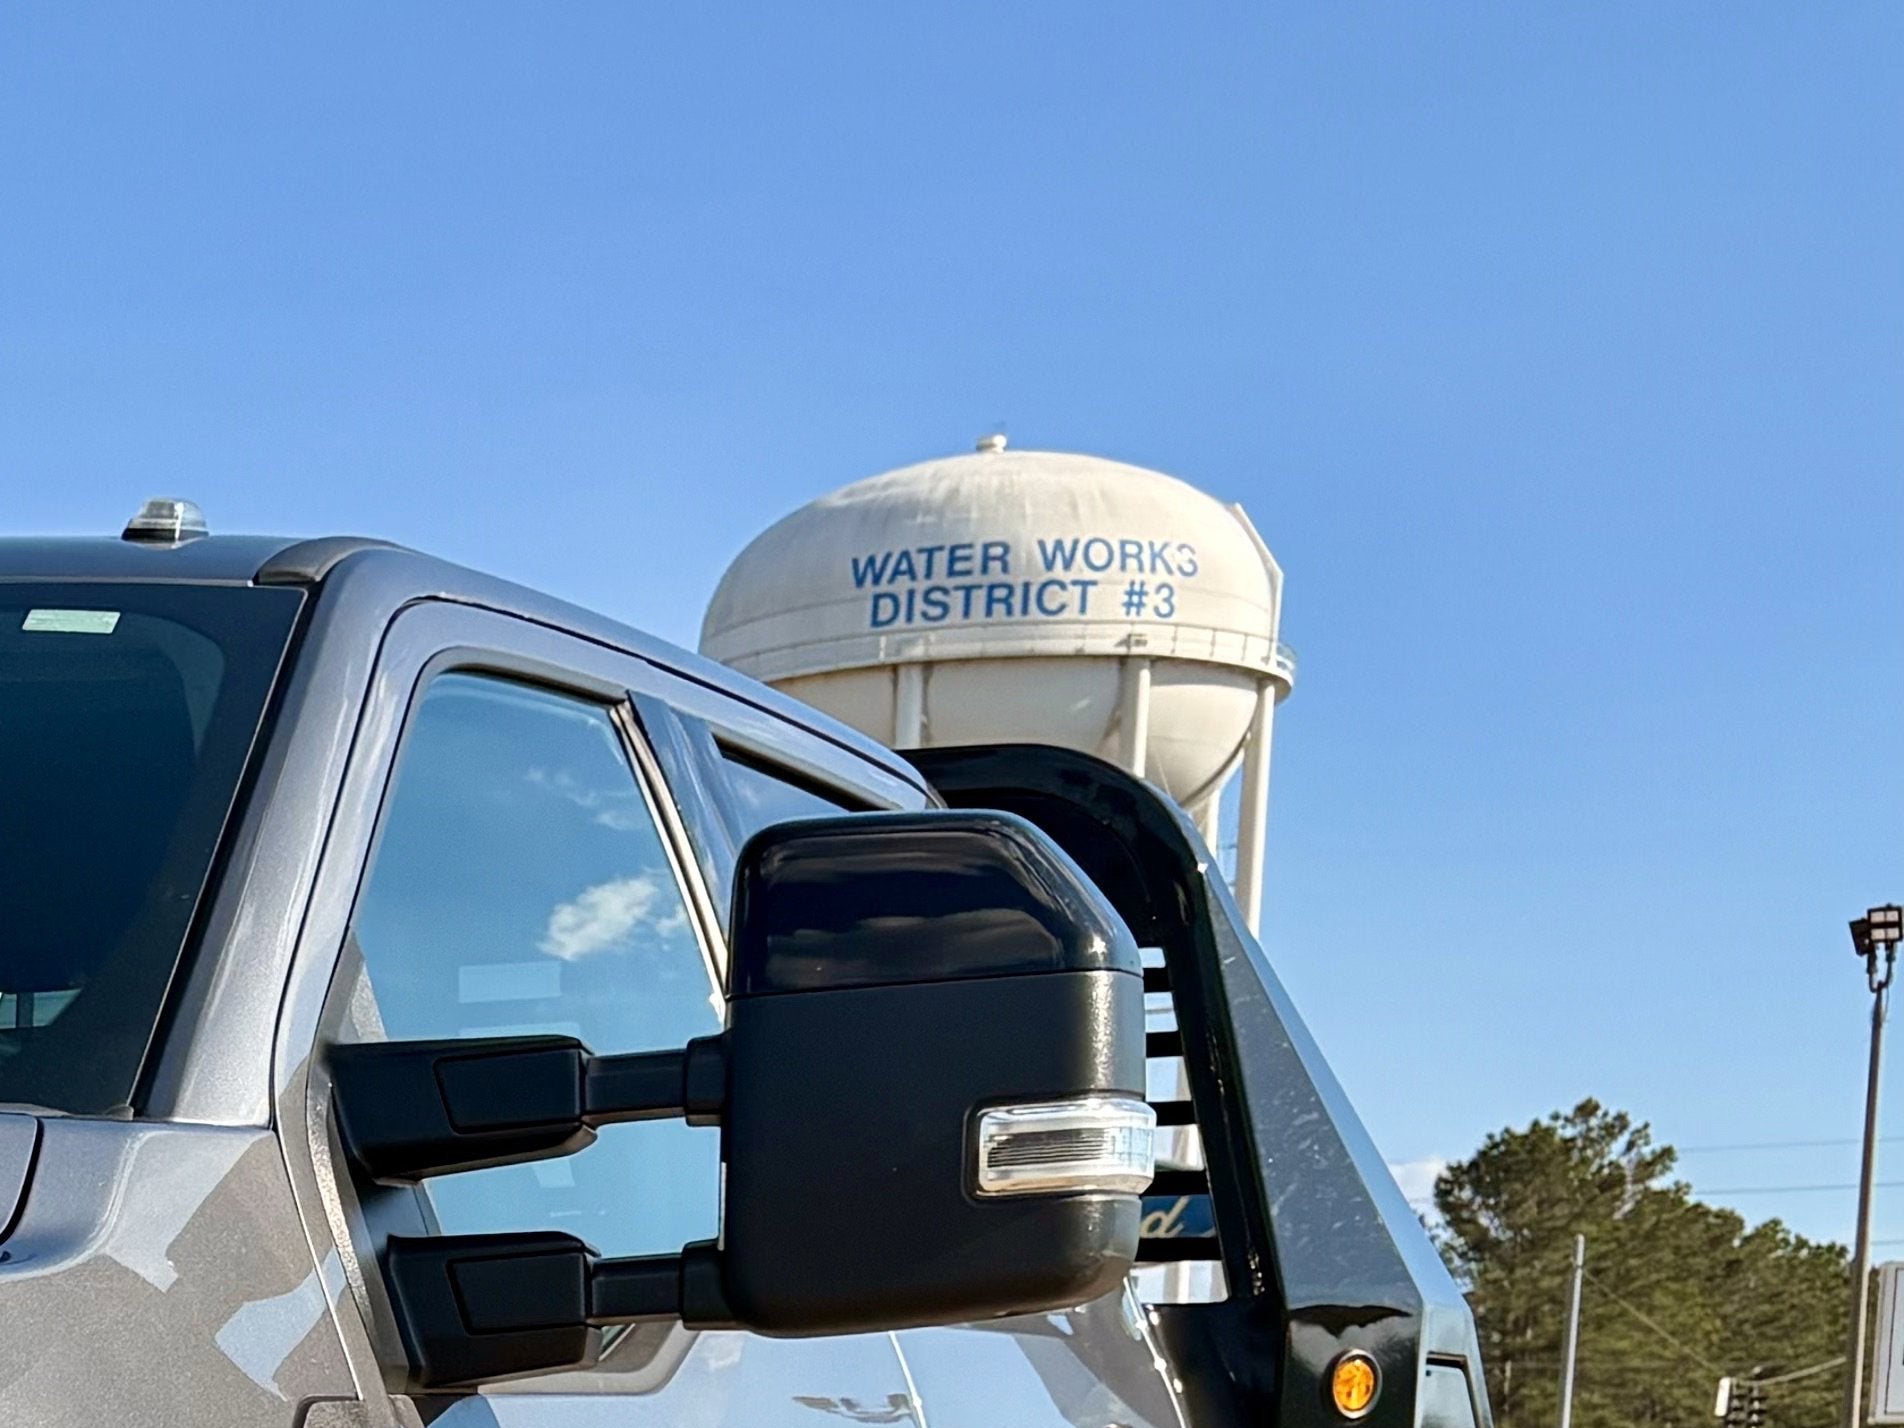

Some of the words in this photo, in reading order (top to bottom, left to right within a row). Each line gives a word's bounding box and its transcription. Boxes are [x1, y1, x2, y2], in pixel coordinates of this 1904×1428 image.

[851, 540, 1011, 590] WATER
[869, 578, 1099, 630] DISTRICT
[1121, 581, 1177, 619] #3
